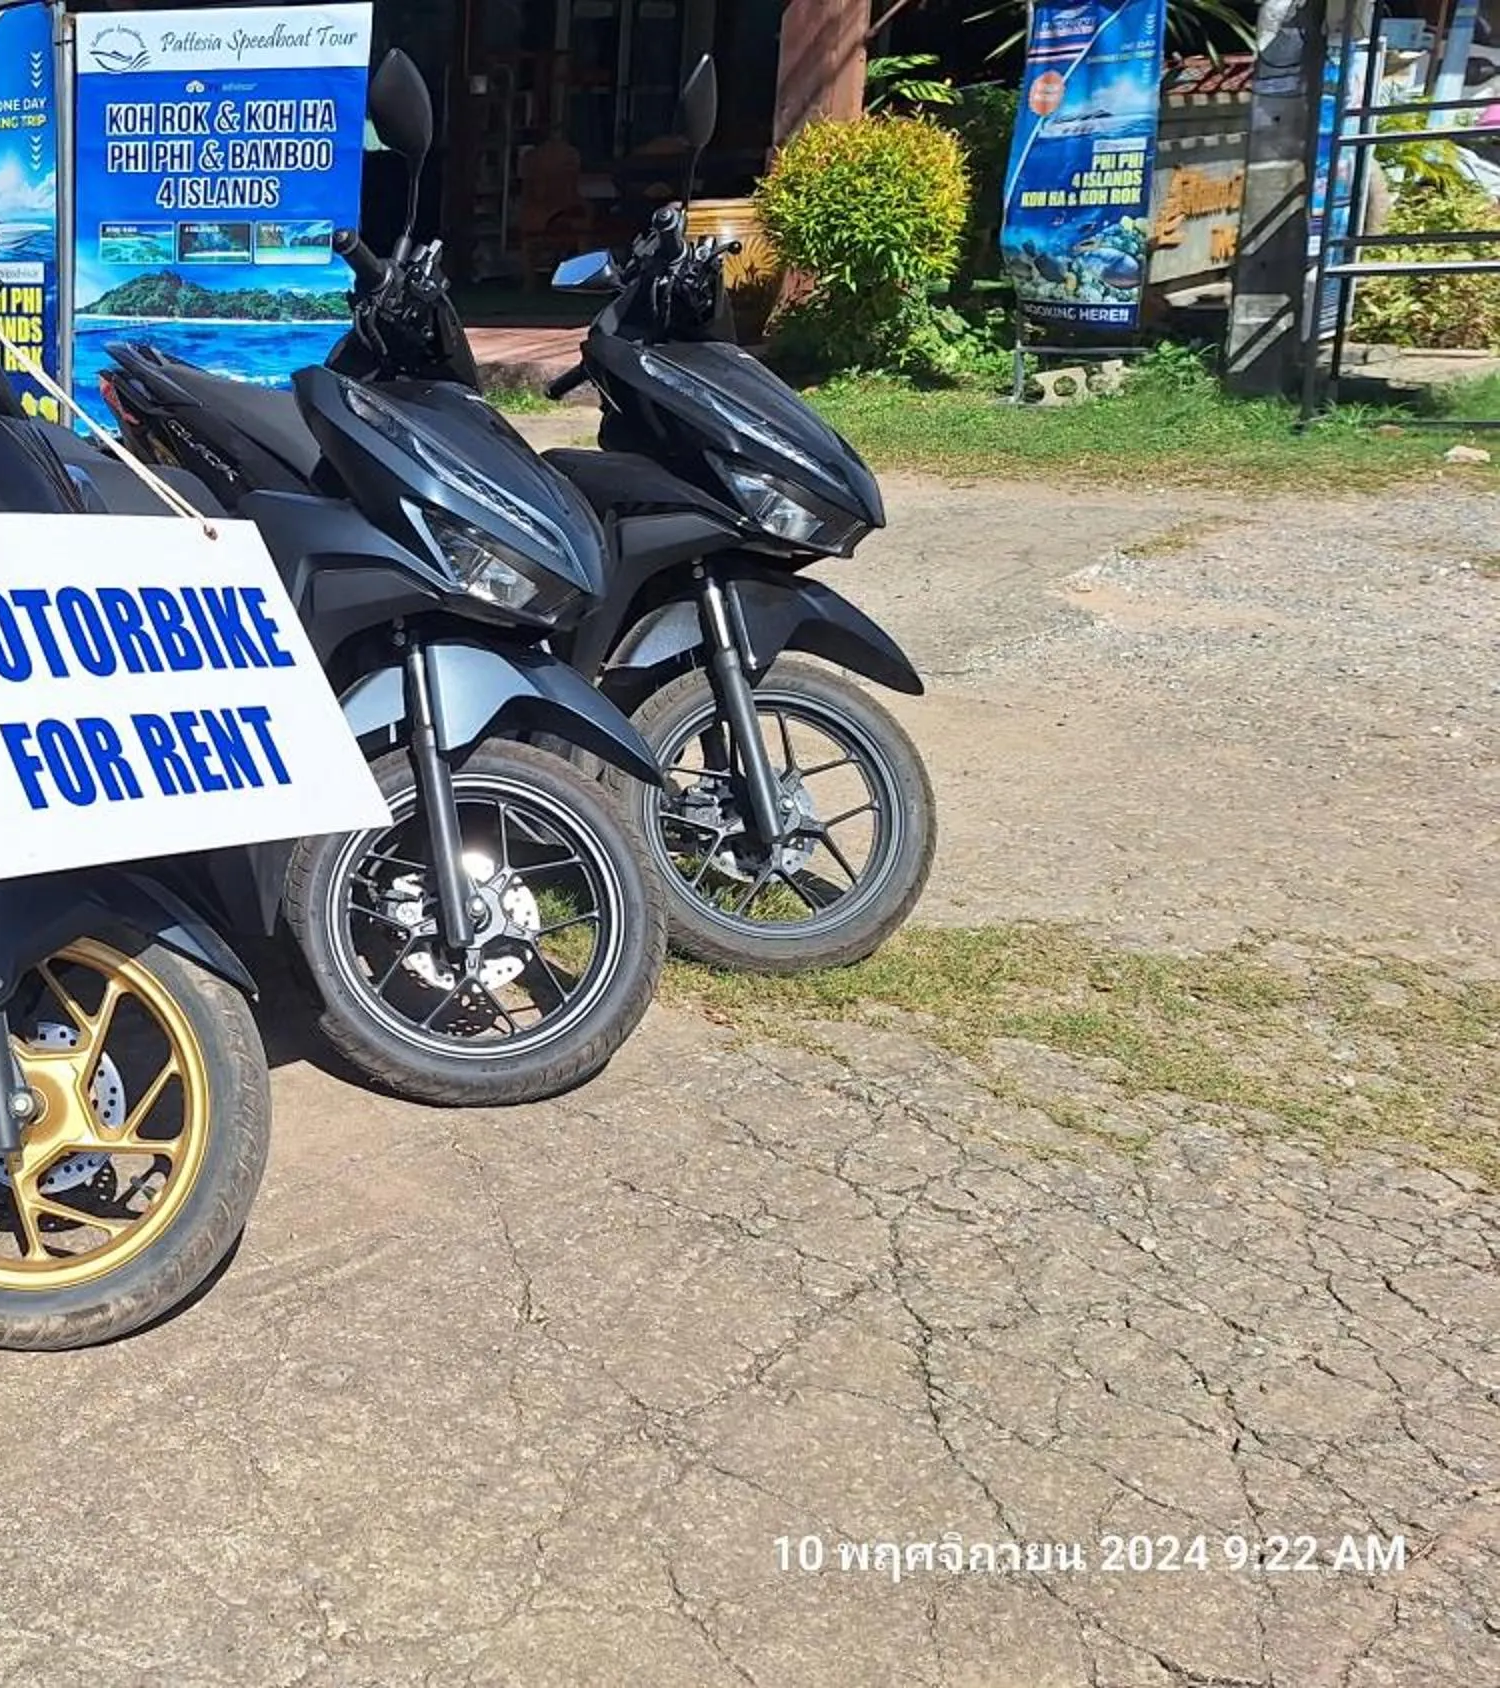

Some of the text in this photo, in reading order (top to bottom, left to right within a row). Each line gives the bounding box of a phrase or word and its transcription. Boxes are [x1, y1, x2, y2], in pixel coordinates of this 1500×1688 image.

[226, 23, 311, 61] Speedboat
[316, 25, 359, 47] Tour
[23, 97, 47, 110] DAY
[106, 99, 336, 136] KOH ROK & KOH HA
[20, 114, 47, 127] TRIP
[107, 139, 332, 172] PHI PHI & BAMBOO
[156, 177, 279, 209] 4 ISLANDS
[1082, 170, 1143, 188] ISLANDS
[11, 287, 43, 313] PHI
[0, 705, 292, 810] FOR RENT
